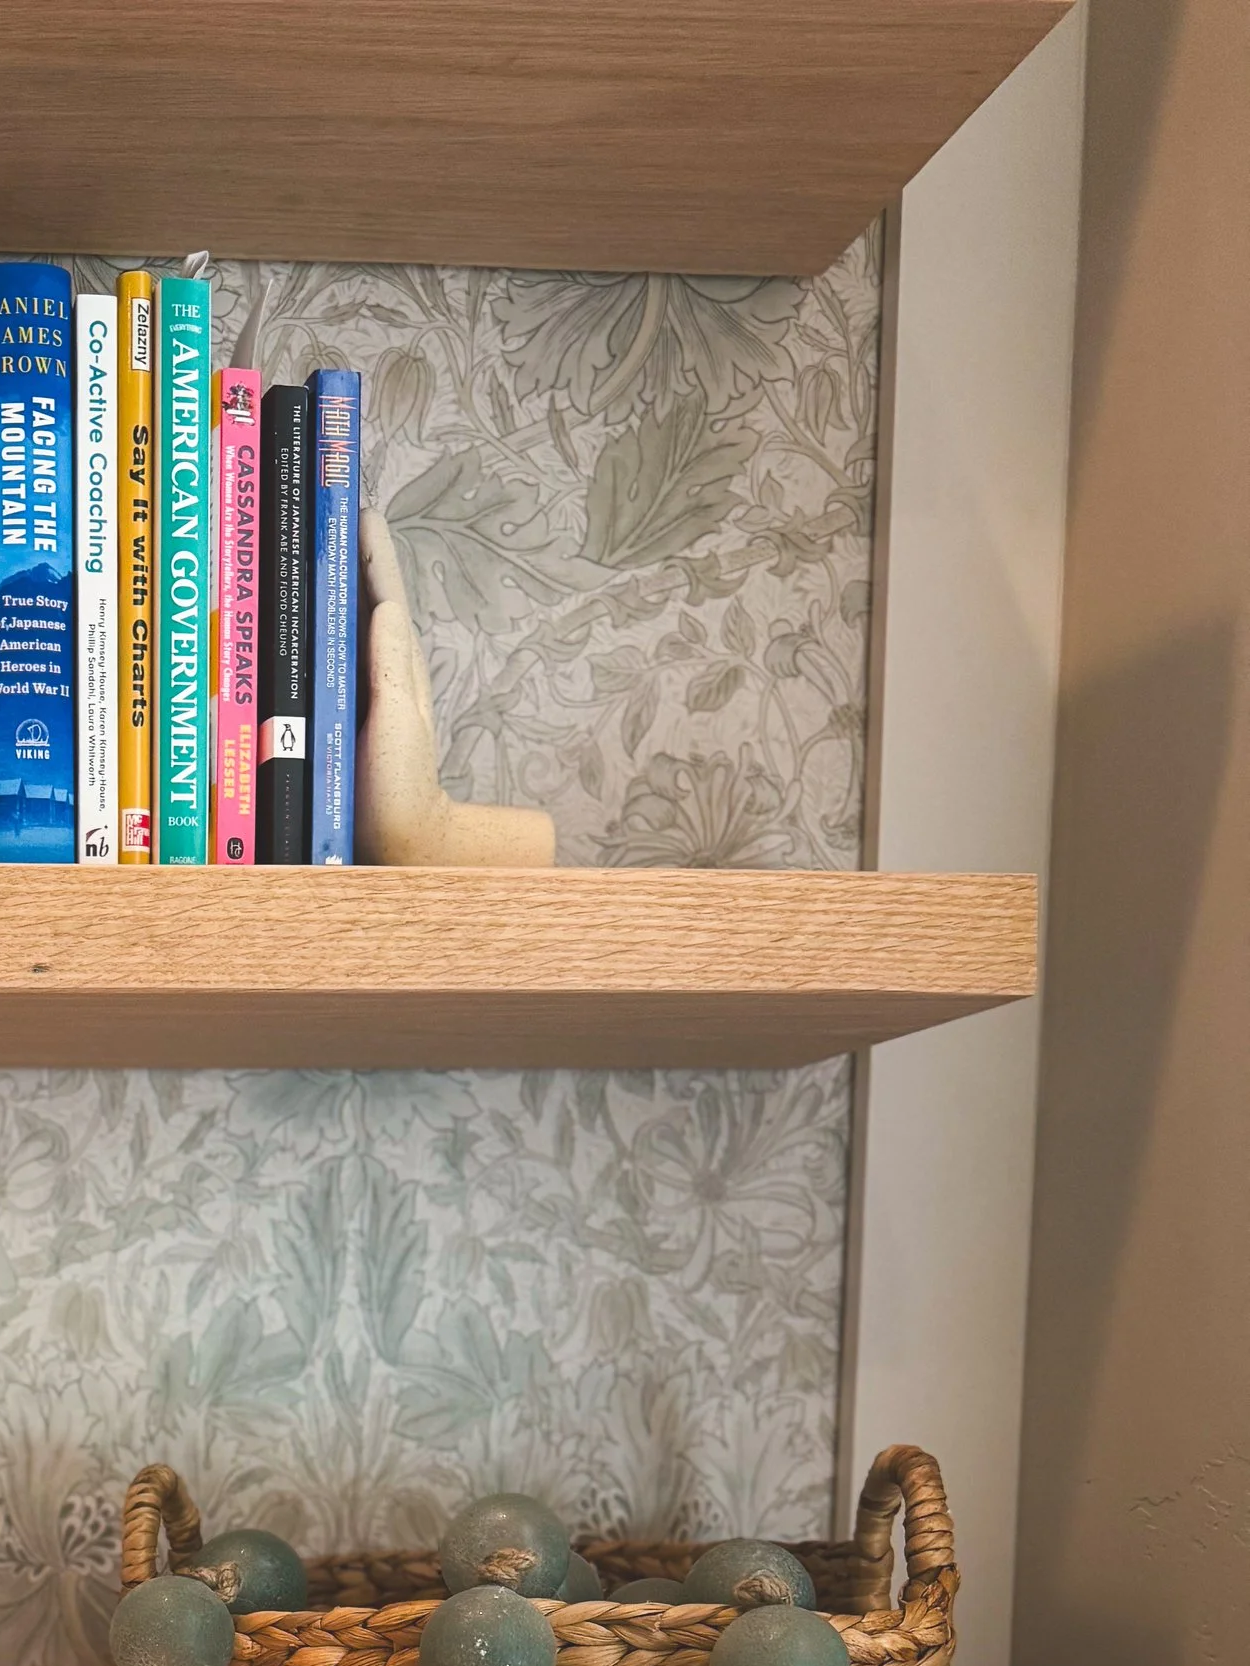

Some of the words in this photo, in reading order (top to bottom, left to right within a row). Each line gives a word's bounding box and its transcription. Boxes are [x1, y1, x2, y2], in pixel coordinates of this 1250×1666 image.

[171, 303, 201, 319] THE
[134, 303, 149, 365] Zelazny
[89, 320, 108, 443] Co-Active
[293, 405, 301, 427] THE
[318, 395, 357, 438] MATH
[32, 396, 56, 494] FACING
[129, 424, 149, 486] Say
[171, 337, 200, 539] AMERICAN
[292, 429, 301, 484] LITERATURE
[0, 402, 27, 545] MOUNTAIN
[280, 448, 289, 481] EDITED
[318, 439, 357, 489] MAGIC
[280, 484, 288, 496] BY
[292, 488, 300, 501] OF
[340, 497, 349, 513] THE
[33, 502, 57, 553] THE
[85, 453, 108, 573] Coaching
[132, 499, 149, 523] It
[236, 444, 255, 601] CASSANDRA
[280, 499, 288, 532] FRANK
[291, 505, 300, 556] JAPANESE
[339, 515, 348, 546] HUMAN
[280, 534, 288, 553] ABE
[328, 517, 337, 562] EVERYDAY
[132, 535, 149, 606] with
[280, 556, 288, 578] AND
[291, 559, 300, 613] AMERICAN
[328, 564, 336, 588] MATH
[338, 548, 348, 606] CALCULATOR
[2, 595, 33, 606] True
[36, 595, 68, 611] Story
[279, 581, 287, 610] FLOYD
[327, 589, 336, 635] PROBLEMS
[8, 617, 66, 631] Japanese
[279, 614, 287, 657] CHEUNG
[338, 607, 347, 639] SHOWS
[0, 639, 62, 652] American
[235, 611, 253, 705] SPEAKS
[290, 616, 299, 699] INCARCERATION
[337, 640, 347, 661] HOW
[0, 660, 46, 673] Heroes
[49, 661, 61, 674] in
[132, 619, 148, 728] Charts
[169, 548, 200, 809] GOVERNMENT
[326, 648, 335, 688] SECONDS
[337, 662, 347, 674] TO
[32, 683, 57, 696] War
[60, 685, 70, 697] II
[337, 675, 346, 710] MASTER
[15, 749, 50, 760] VIKING
[334, 723, 343, 759] SCOTT
[223, 740, 236, 799] LESSER
[238, 724, 251, 815] ELIZABETH
[333, 762, 342, 830] FLANSBURG
[168, 816, 199, 827] BOOK
